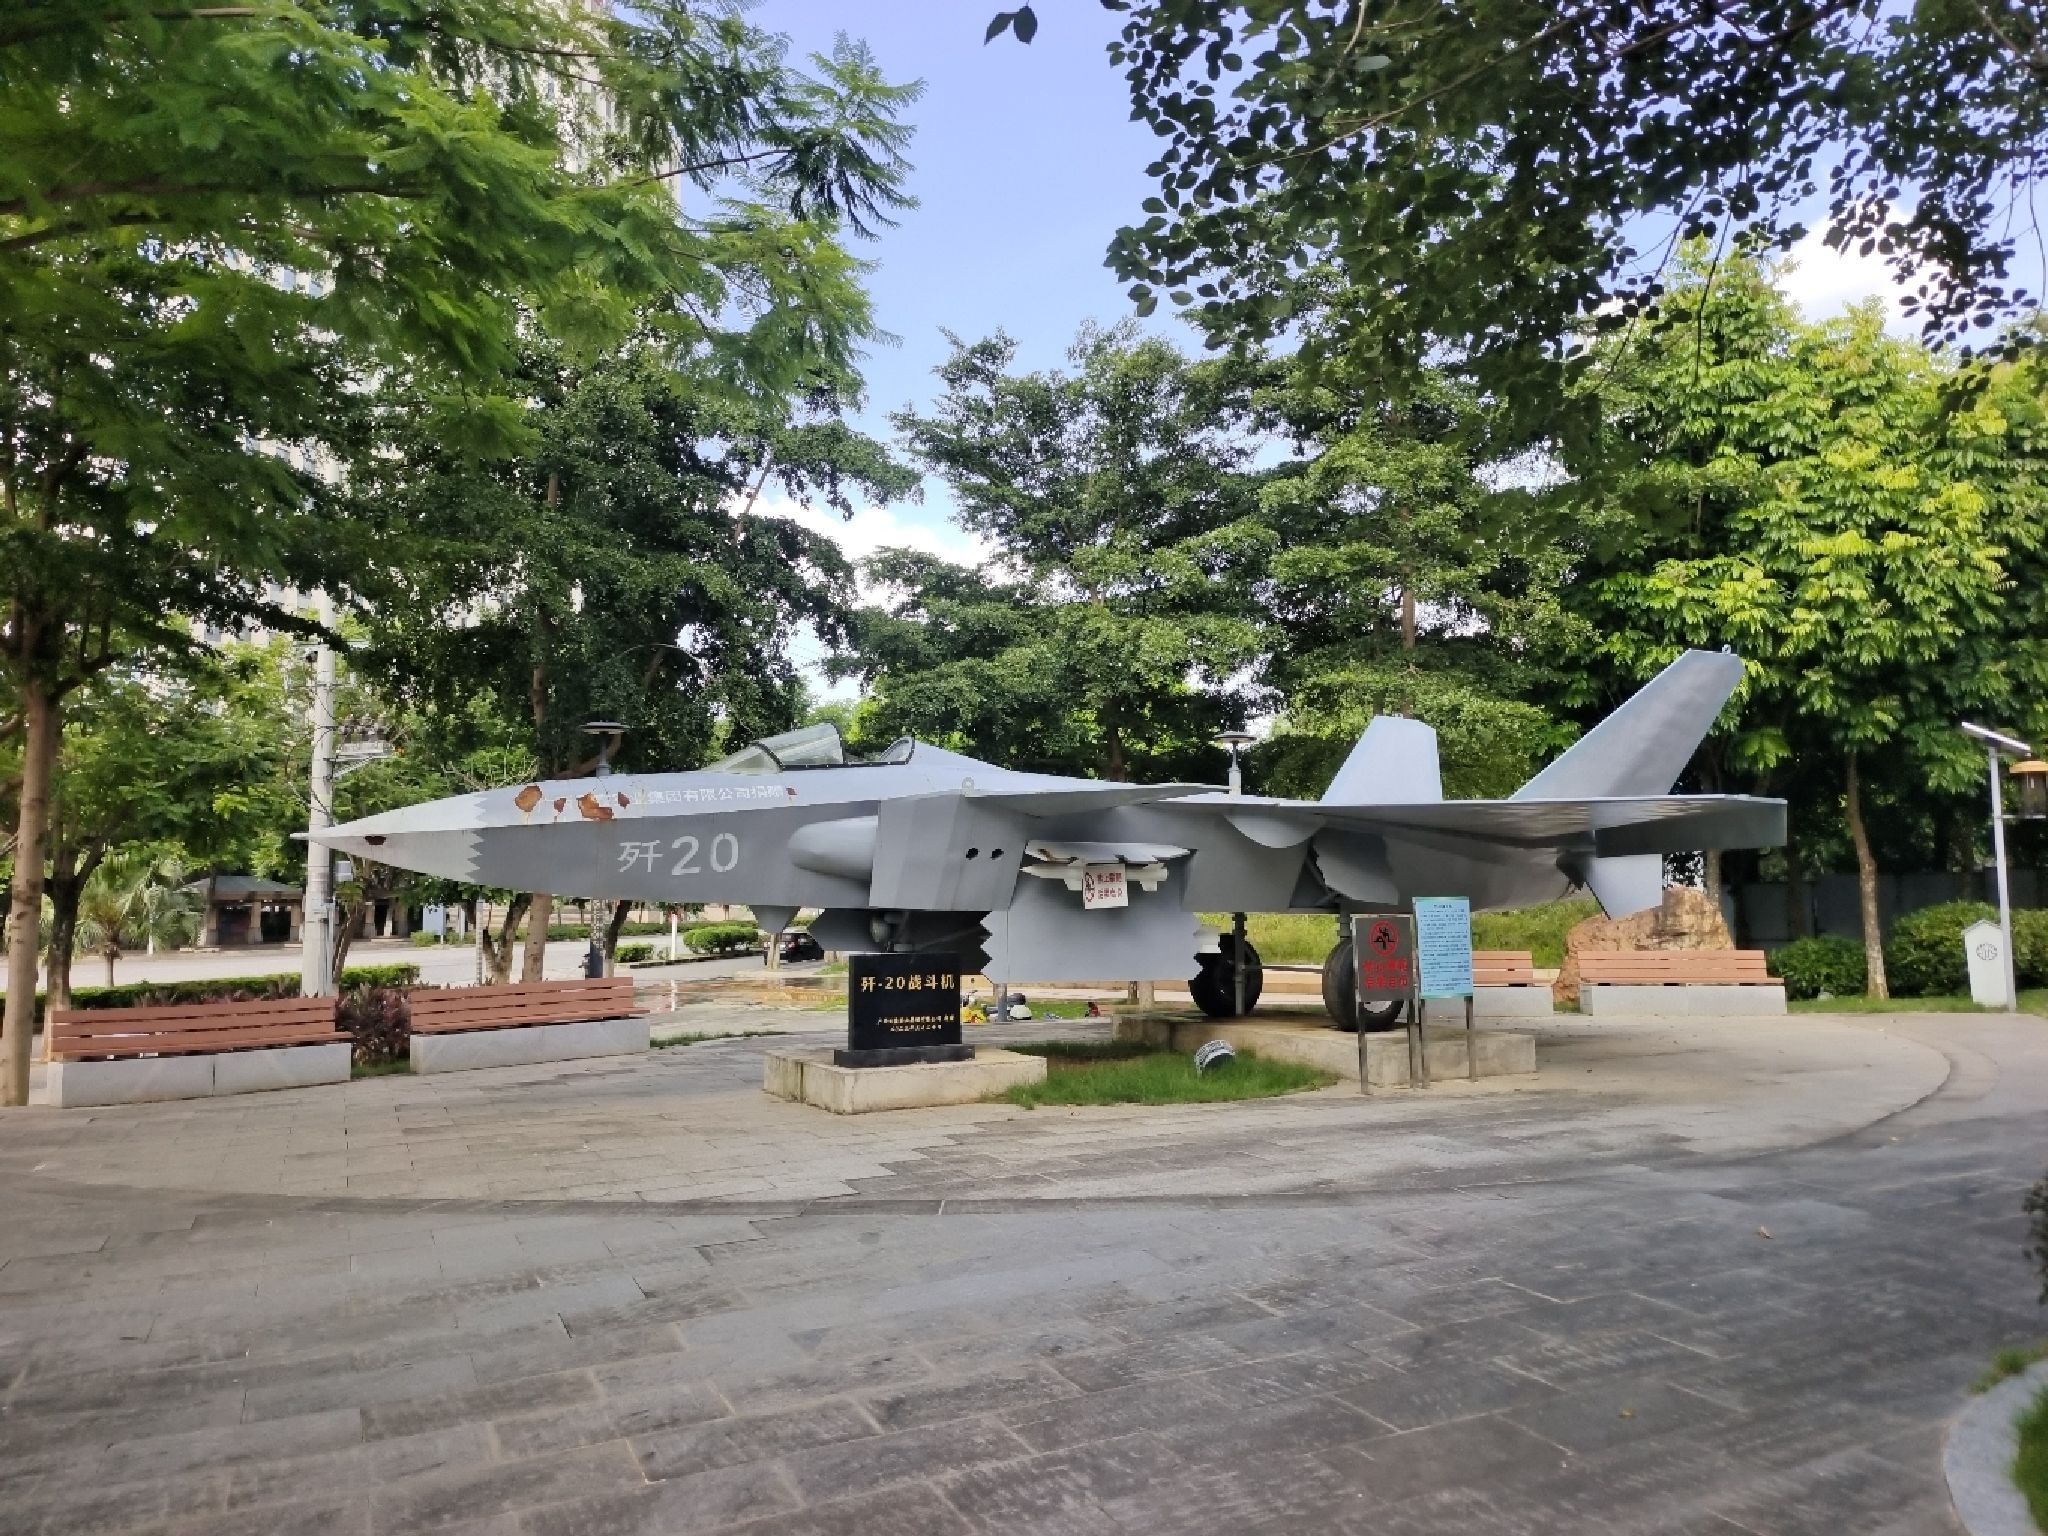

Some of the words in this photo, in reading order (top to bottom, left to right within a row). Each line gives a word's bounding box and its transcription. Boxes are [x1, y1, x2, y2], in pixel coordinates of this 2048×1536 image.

[617, 833, 739, 876] 歼20
[861, 974, 955, 992] 歼-20战斗机
